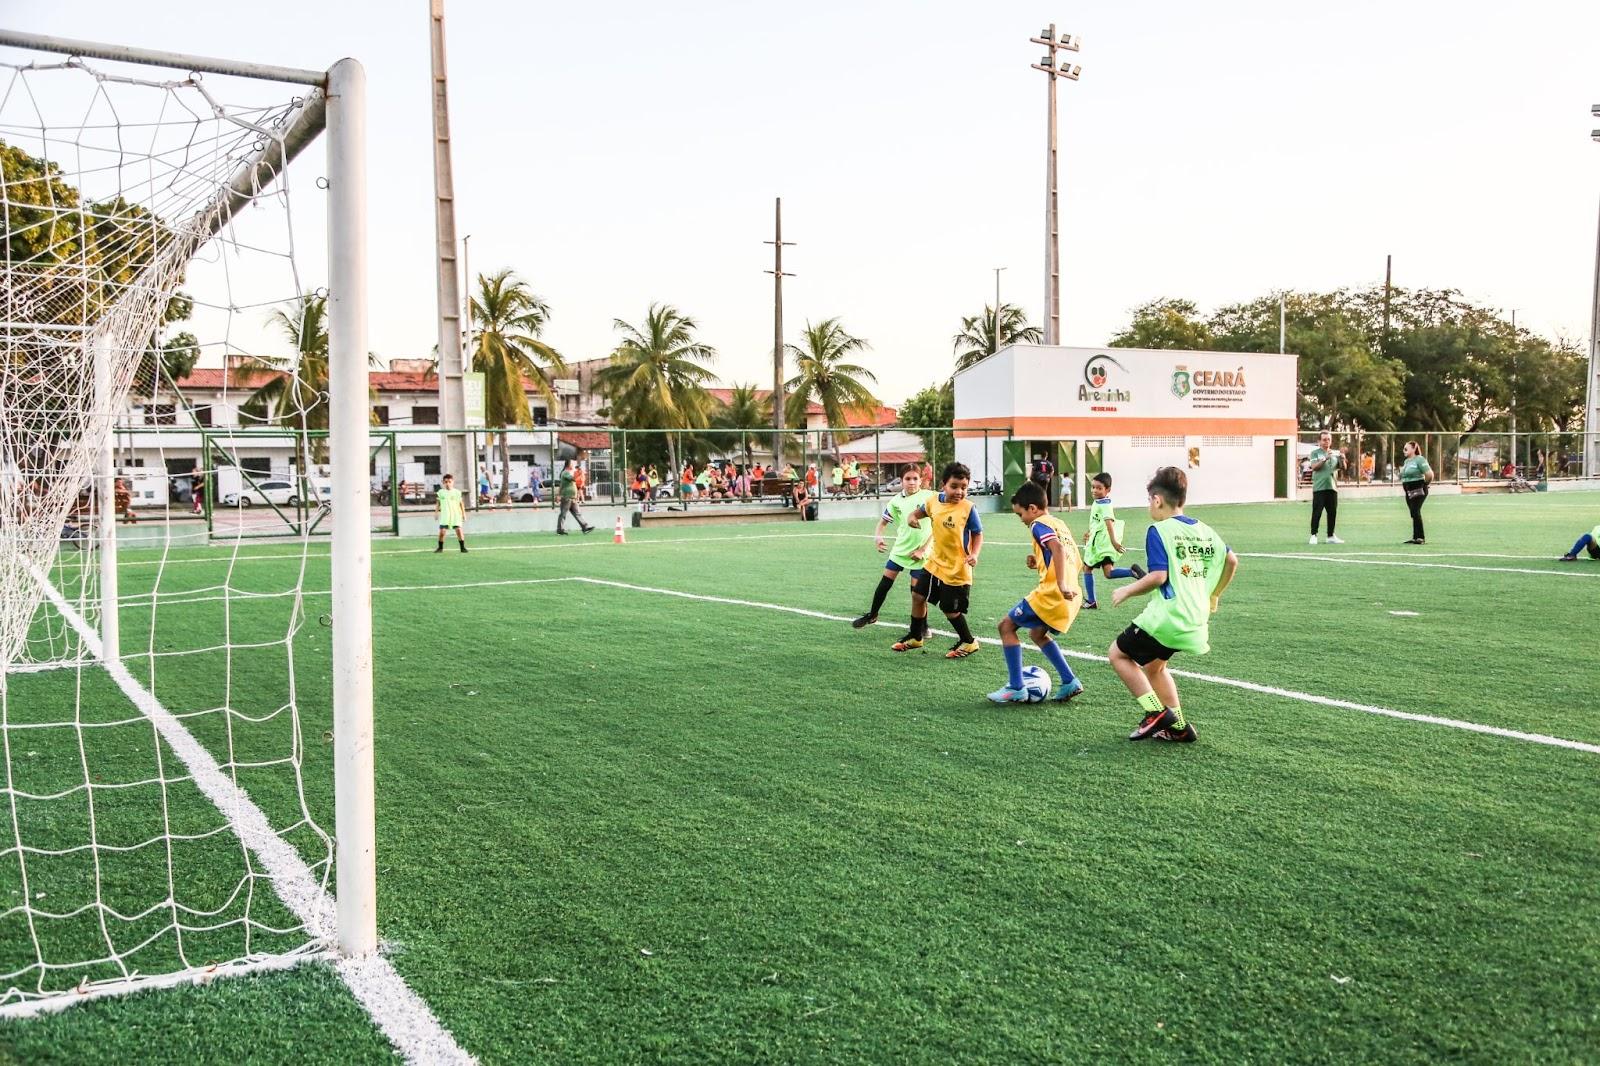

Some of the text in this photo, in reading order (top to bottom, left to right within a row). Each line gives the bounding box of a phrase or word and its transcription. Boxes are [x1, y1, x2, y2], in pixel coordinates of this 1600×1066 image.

[1193, 366, 1246, 387] CEARÁ
[1078, 384, 1131, 402] Areninha
[1188, 544, 1215, 555] CEARÁ
